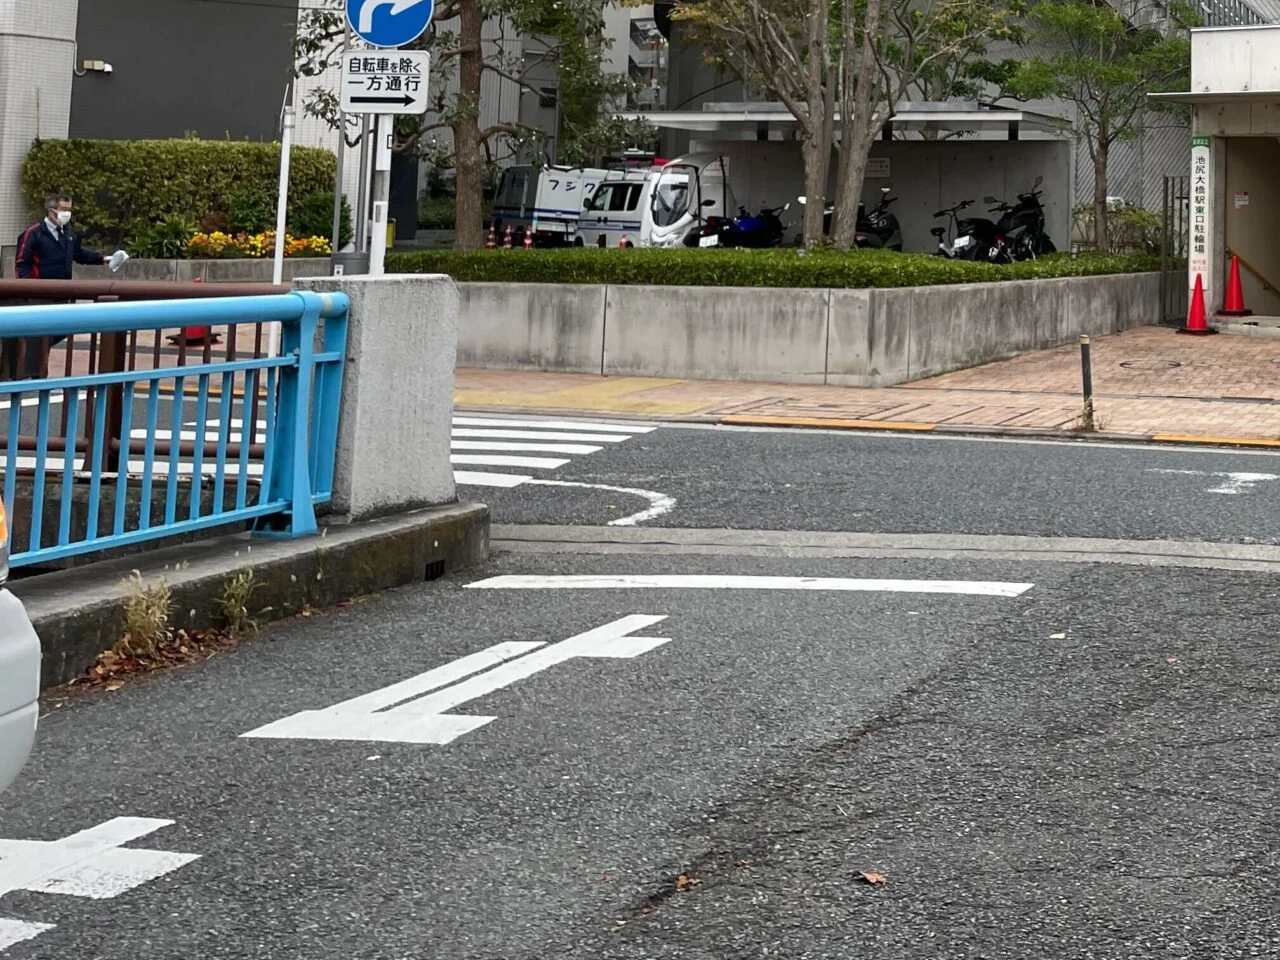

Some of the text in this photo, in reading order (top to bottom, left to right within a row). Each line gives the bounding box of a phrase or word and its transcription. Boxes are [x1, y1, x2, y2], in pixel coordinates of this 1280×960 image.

[349, 57, 421, 73] 自転車を除く
[347, 75, 421, 92] 一方通行
[1194, 155, 1206, 254] 池尻大橋駅東口駐輪場
